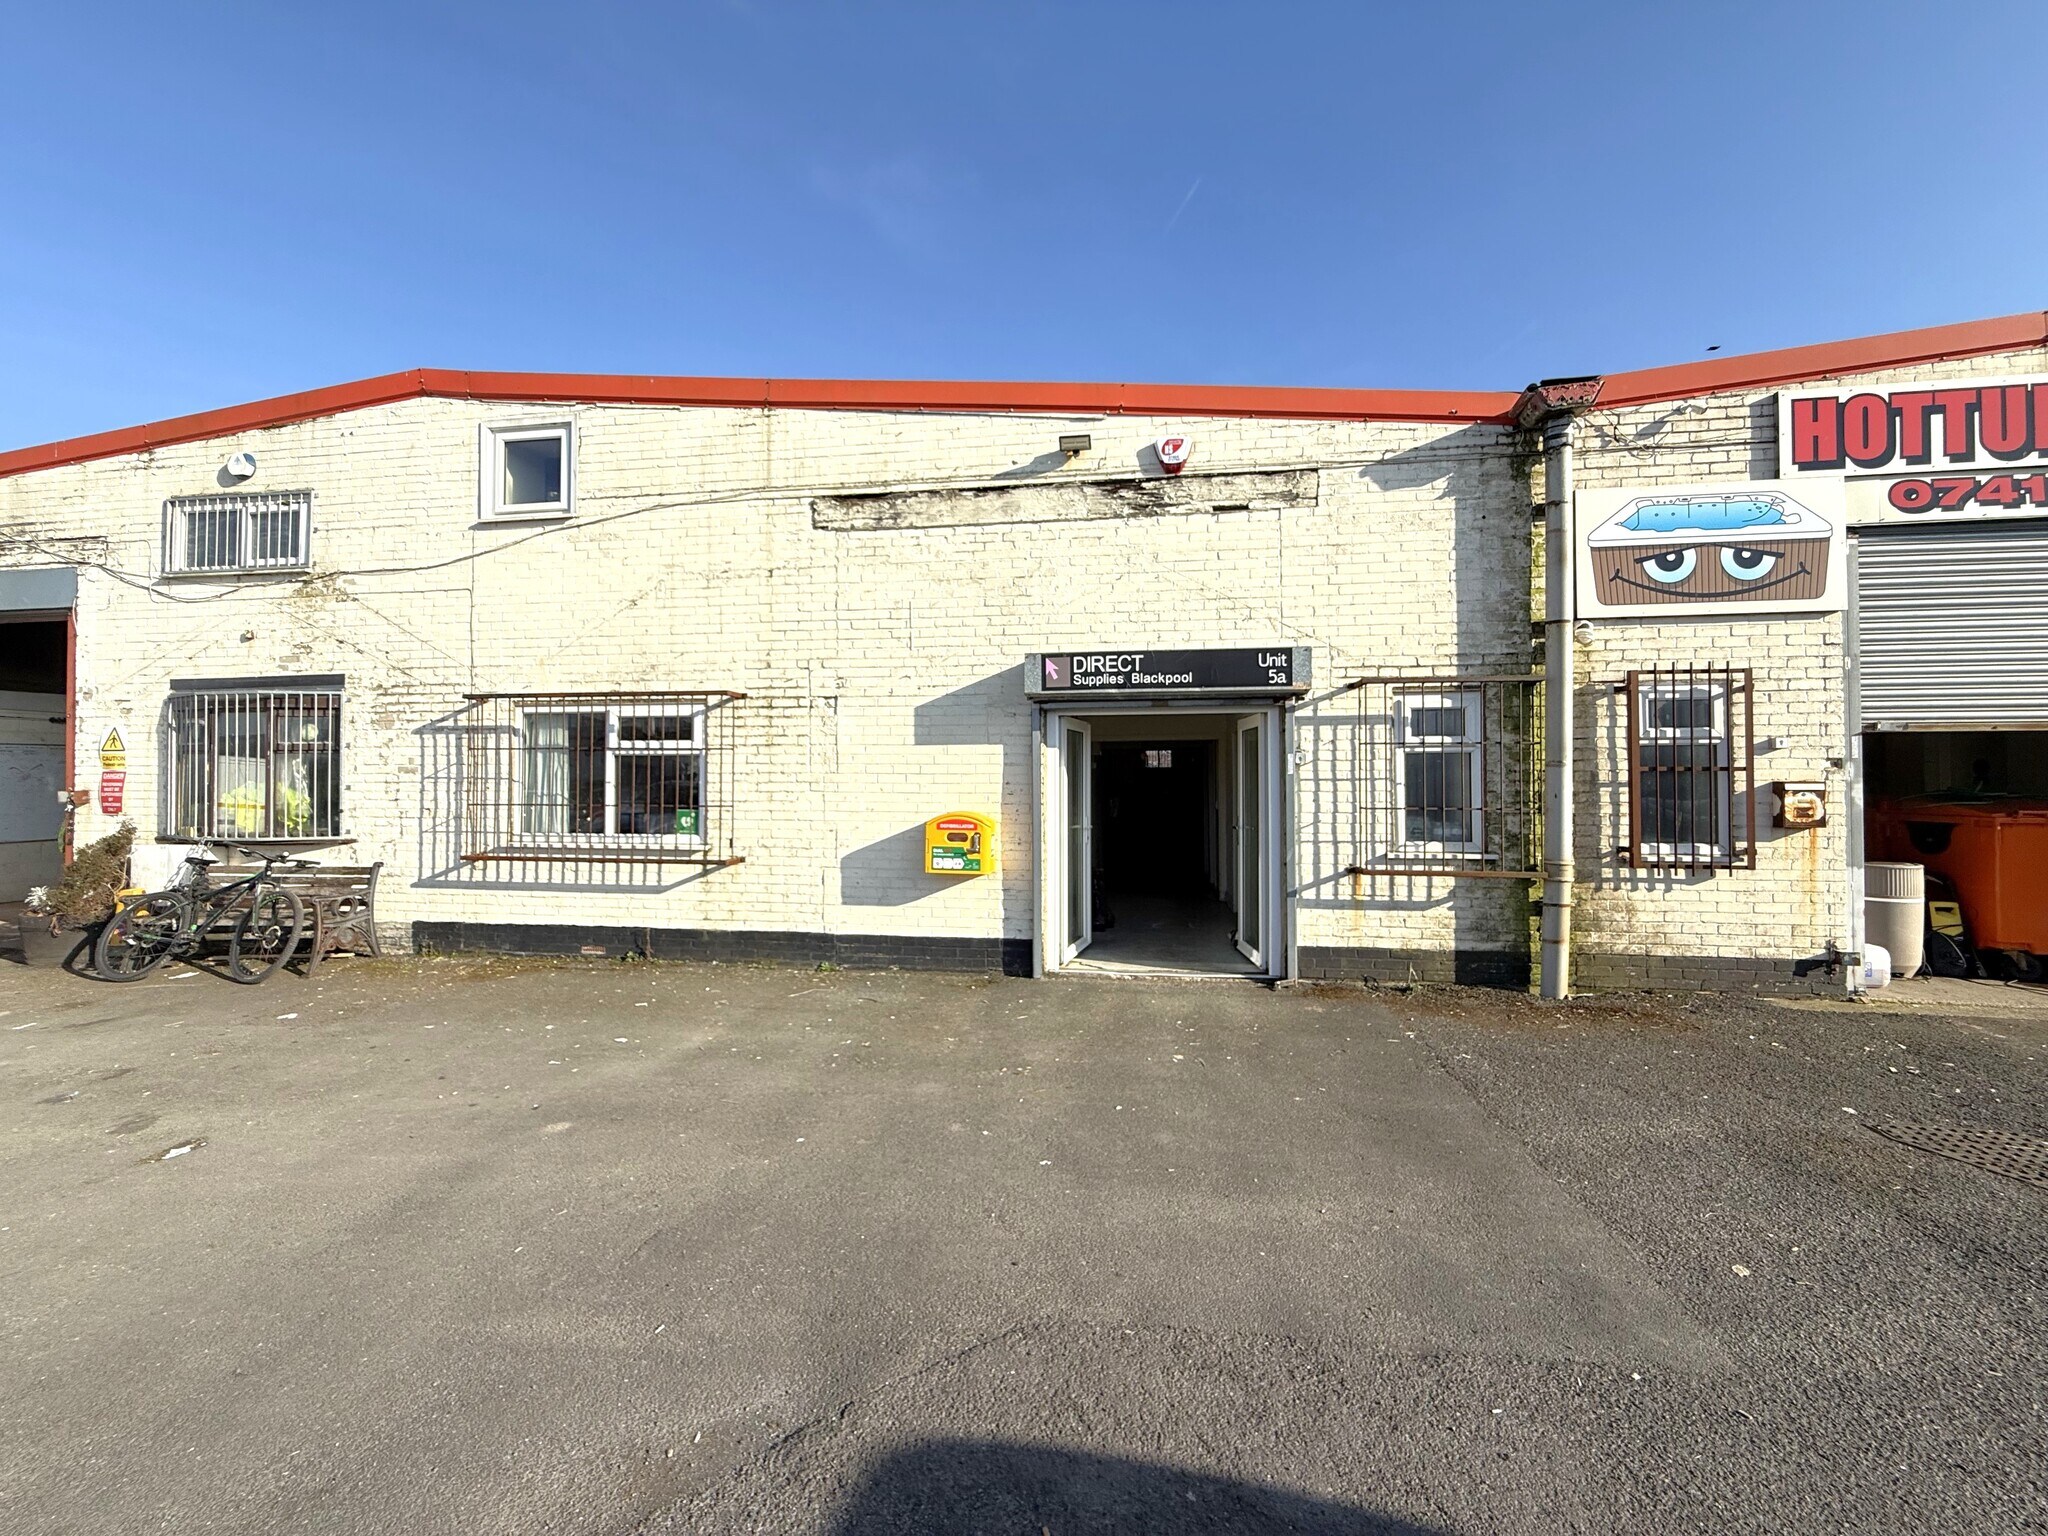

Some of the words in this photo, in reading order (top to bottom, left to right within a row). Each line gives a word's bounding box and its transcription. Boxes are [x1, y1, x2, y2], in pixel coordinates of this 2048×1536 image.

[1073, 654, 1144, 674] DIRECT
[1258, 652, 1287, 667] Unit
[1073, 673, 1124, 686] Supplies
[1131, 671, 1193, 685] Blackpool
[1268, 669, 1287, 684] 5a
